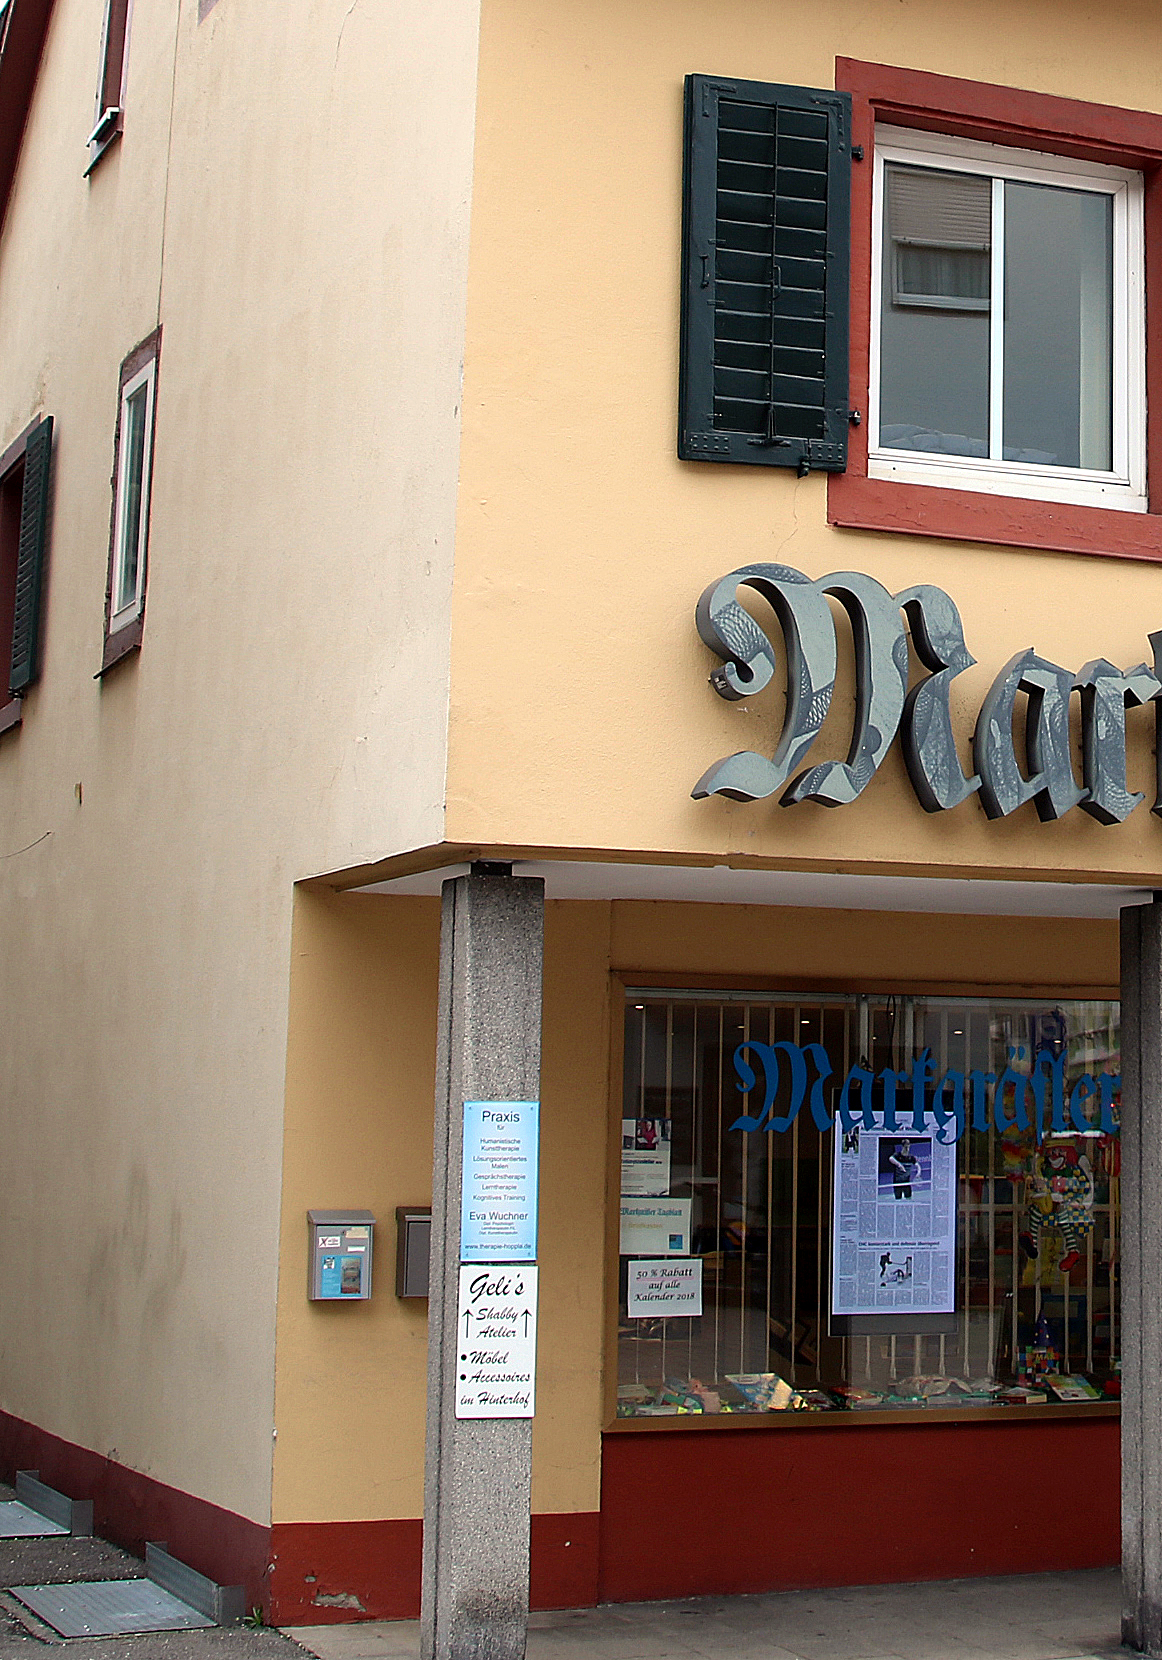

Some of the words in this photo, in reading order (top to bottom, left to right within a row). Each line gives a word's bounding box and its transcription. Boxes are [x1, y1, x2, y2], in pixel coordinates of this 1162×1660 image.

[482, 1110, 520, 1123] Praxis
[481, 1145, 520, 1153] Kunsttherapie
[472, 1155, 527, 1163] Lösungsorientiertes
[473, 1173, 526, 1181] Gesprächstherapie
[472, 1194, 502, 1202] Kognitives
[503, 1194, 526, 1202] Training
[469, 1211, 487, 1221] Eva
[488, 1211, 529, 1221] Wuchner
[636, 1270, 648, 1280] 50
[650, 1268, 658, 1277] %
[660, 1267, 693, 1277] Rabatt
[469, 1273, 525, 1304] Geli's
[648, 1281, 663, 1292] auf
[665, 1280, 680, 1289] alle
[634, 1292, 675, 1302] Kalender
[676, 1292, 695, 1301] 2018
[476, 1307, 518, 1323] Shabby
[476, 1325, 517, 1338] Atelier
[469, 1351, 509, 1364] Möbel
[468, 1369, 530, 1383] Accessoires
[460, 1395, 474, 1405] im
[477, 1391, 531, 1409] Hinterhof
